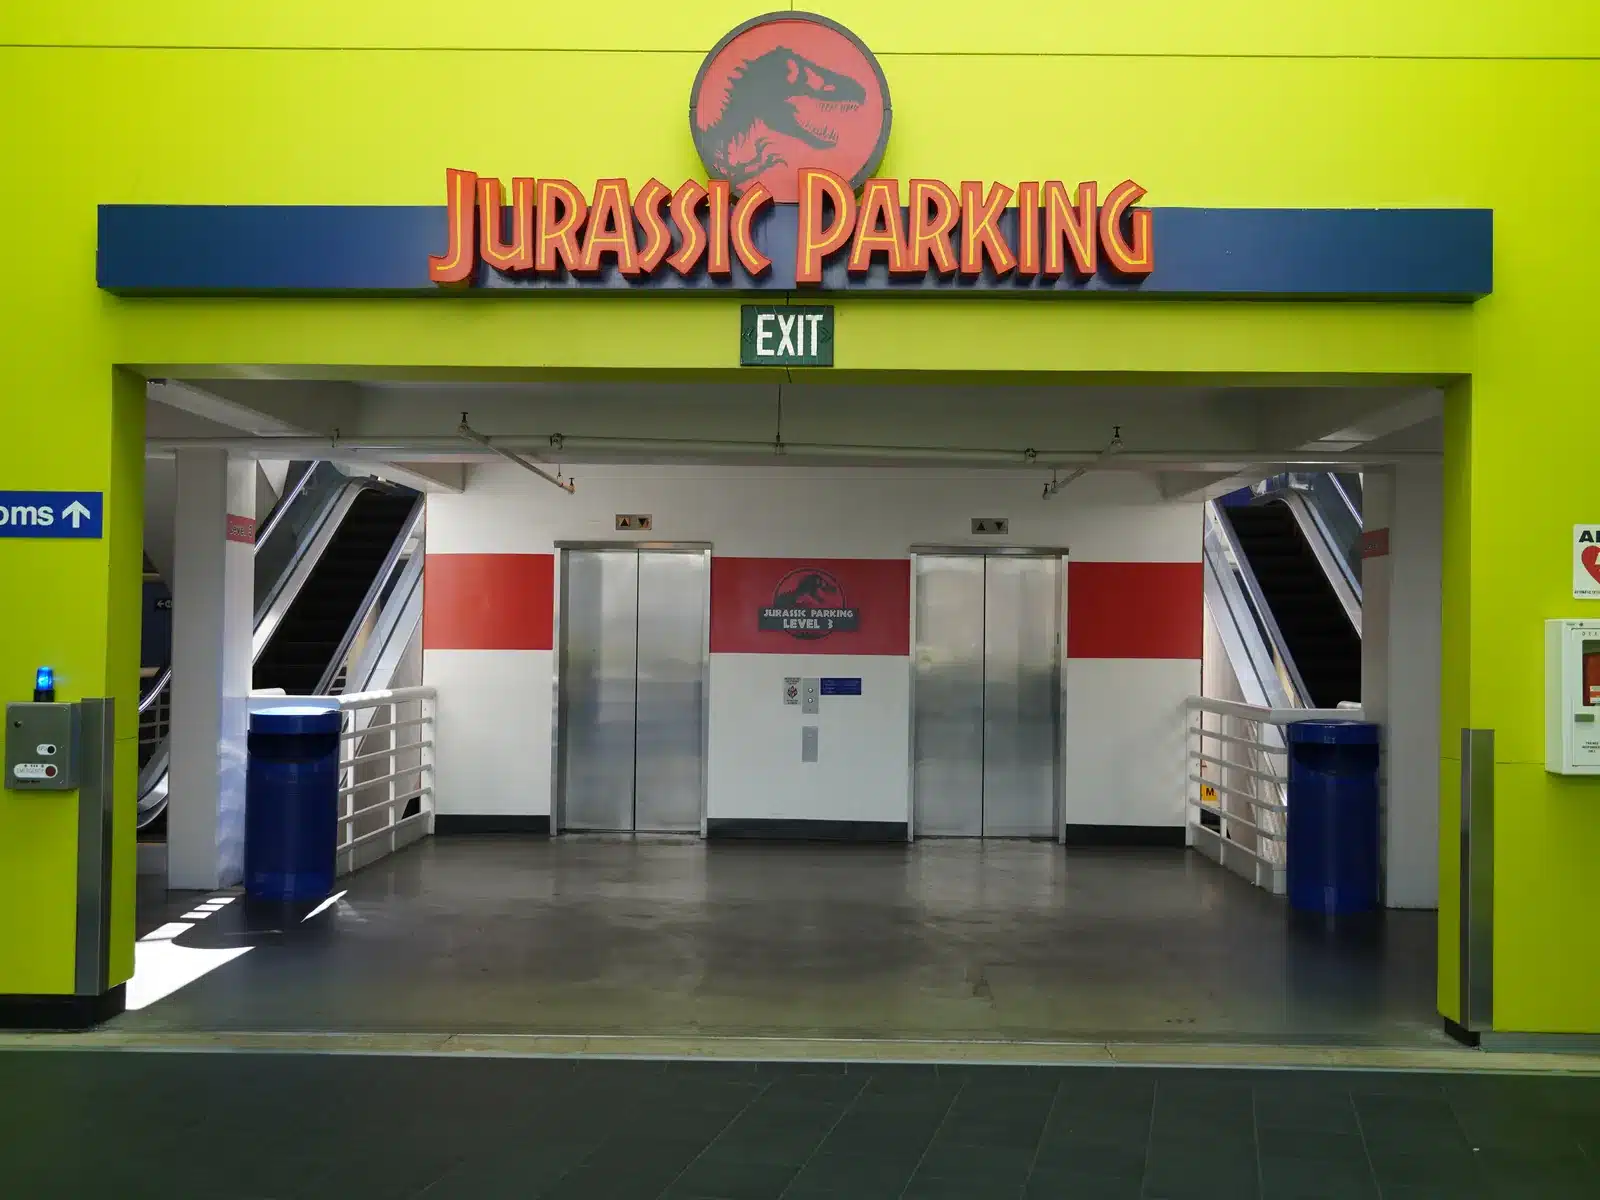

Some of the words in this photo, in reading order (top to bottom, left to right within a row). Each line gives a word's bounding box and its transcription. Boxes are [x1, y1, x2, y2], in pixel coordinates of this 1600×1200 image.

[429, 168, 775, 283] JURASSIC
[796, 168, 1154, 286] PARKING
[756, 314, 824, 356] EXIT
[763, 609, 807, 617] JURASSIC
[811, 609, 854, 618] PARKING
[783, 618, 821, 629] LEVEL
[827, 619, 834, 629] 3
